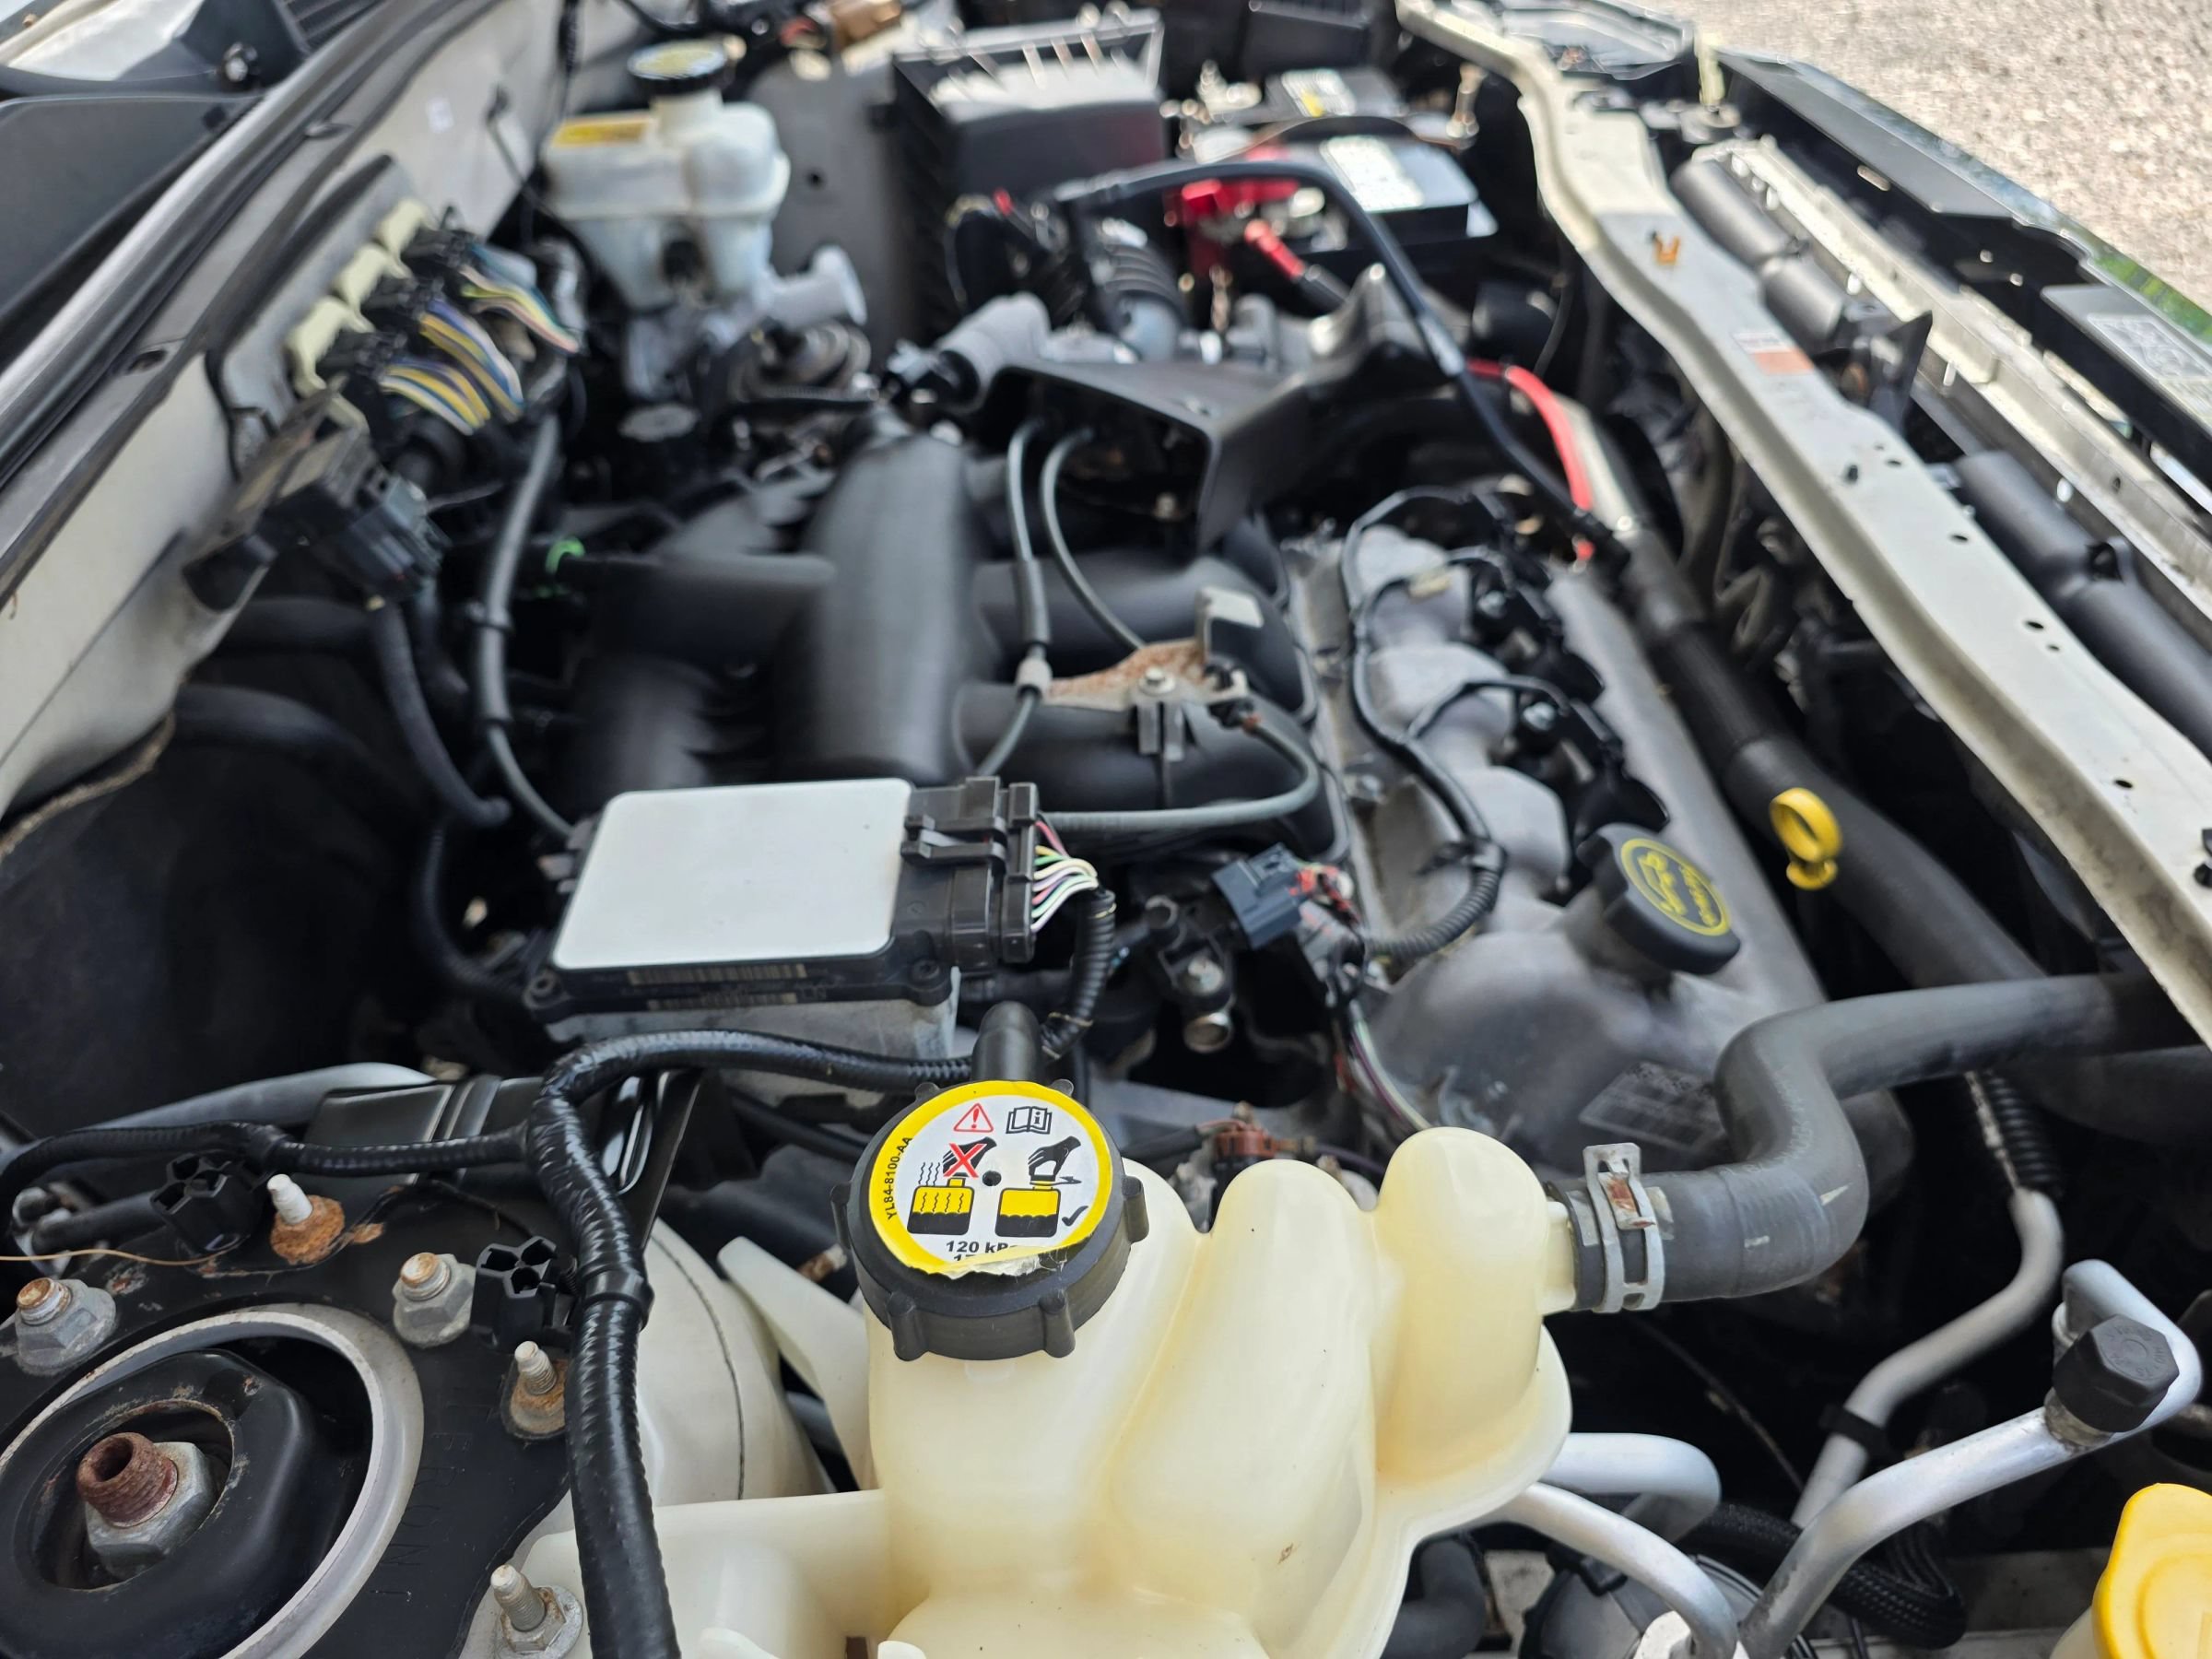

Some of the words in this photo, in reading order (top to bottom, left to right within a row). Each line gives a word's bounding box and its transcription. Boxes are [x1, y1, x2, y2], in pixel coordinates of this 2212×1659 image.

[883, 1136, 913, 1220] YL84-8100-AA
[946, 1240, 980, 1253] 120
[984, 1241, 1018, 1253] kP
